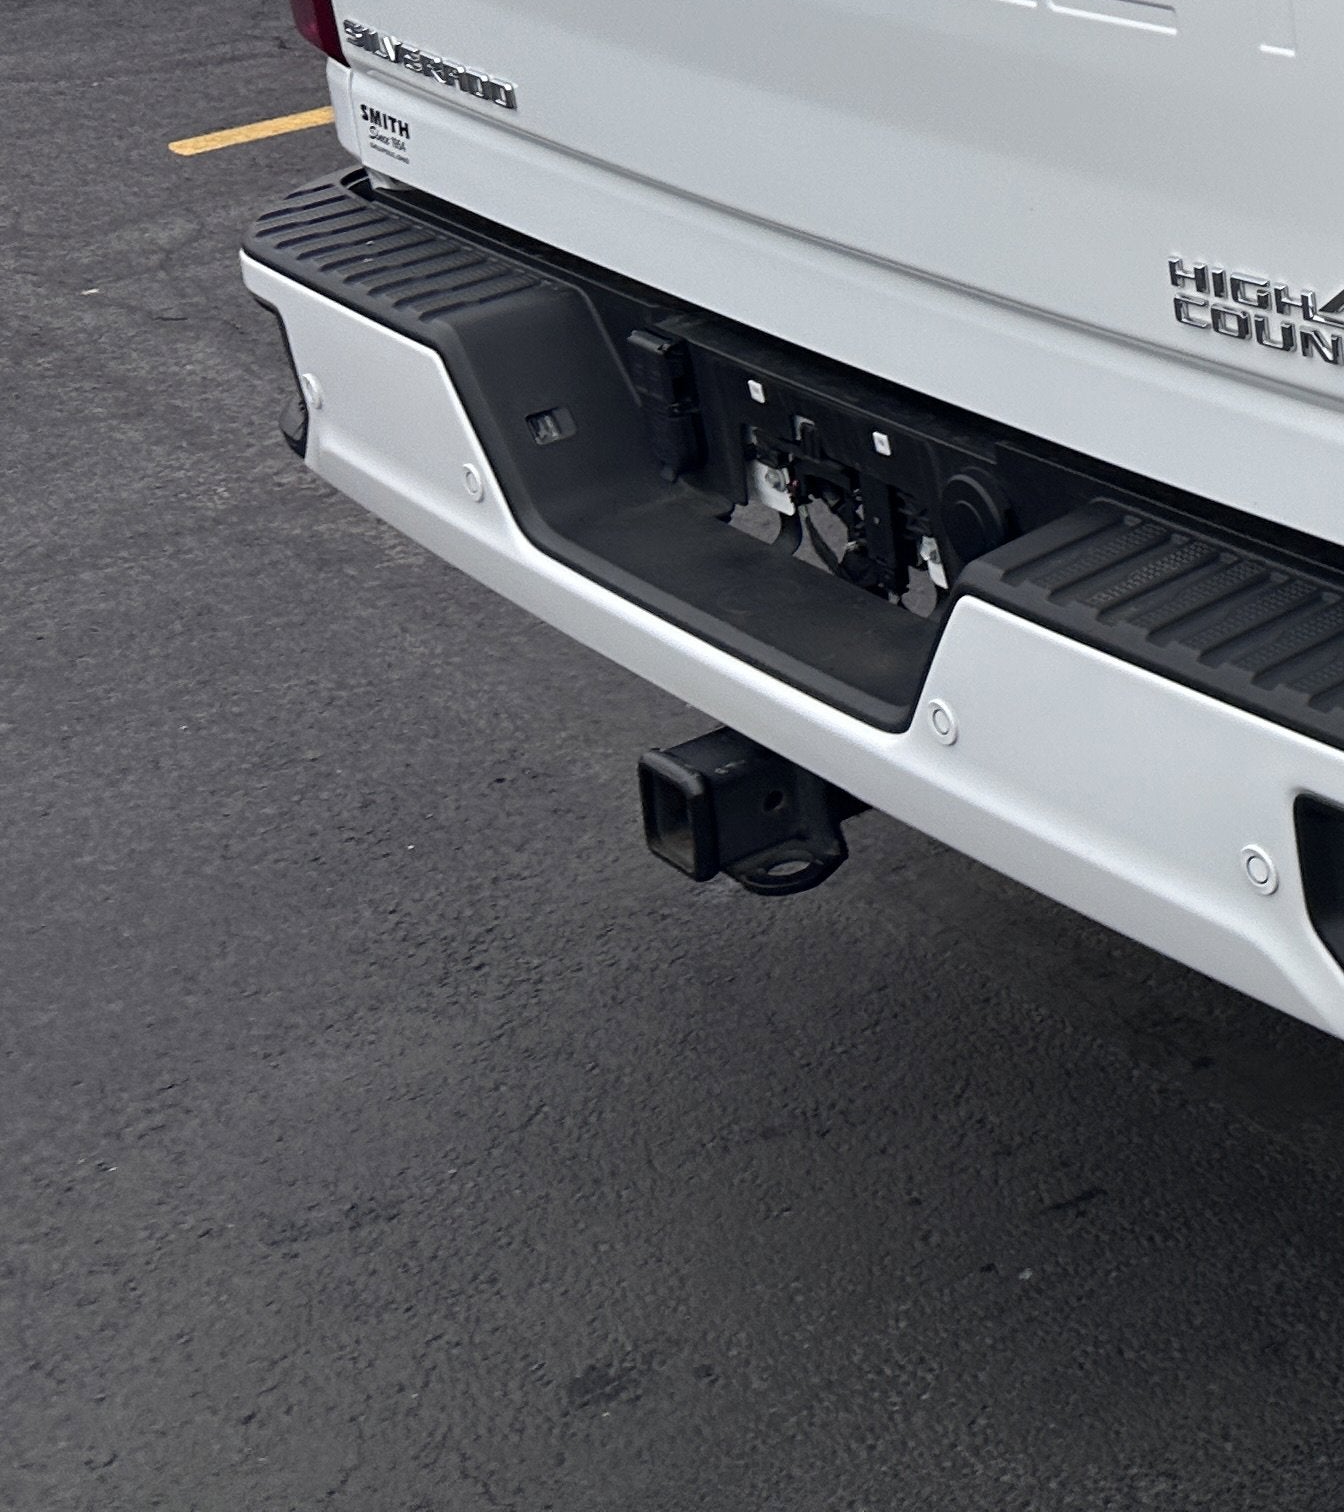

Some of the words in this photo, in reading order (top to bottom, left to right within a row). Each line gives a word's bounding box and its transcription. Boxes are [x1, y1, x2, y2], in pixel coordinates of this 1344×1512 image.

[343, 19, 517, 110] SILVERADO
[360, 104, 410, 139] SMITH
[1168, 256, 1316, 320] HIGH
